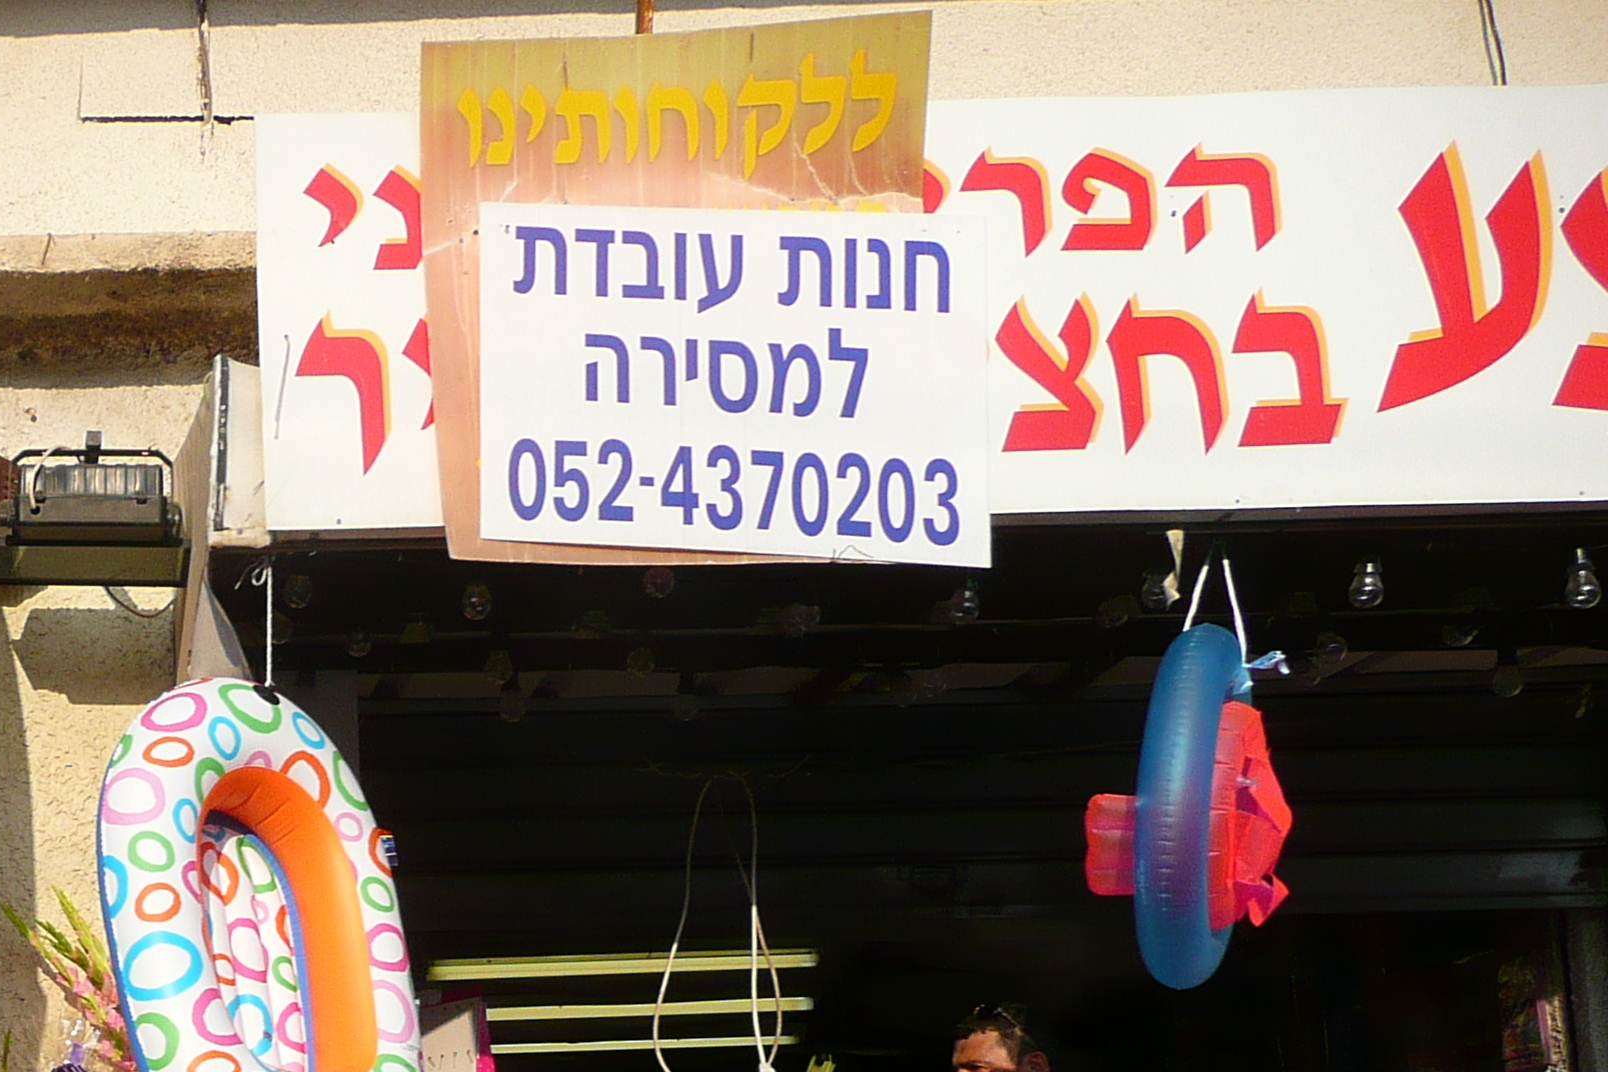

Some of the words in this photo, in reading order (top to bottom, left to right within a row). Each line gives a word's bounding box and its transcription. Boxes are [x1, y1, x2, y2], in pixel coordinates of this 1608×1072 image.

[458, 50, 896, 179] ללקוחותינו
[513, 225, 744, 313] עובדת
[779, 236, 951, 313] חנות
[585, 329, 869, 418] למסירה
[995, 287, 1349, 455] בחצ
[509, 438, 960, 546] 052-4370203
